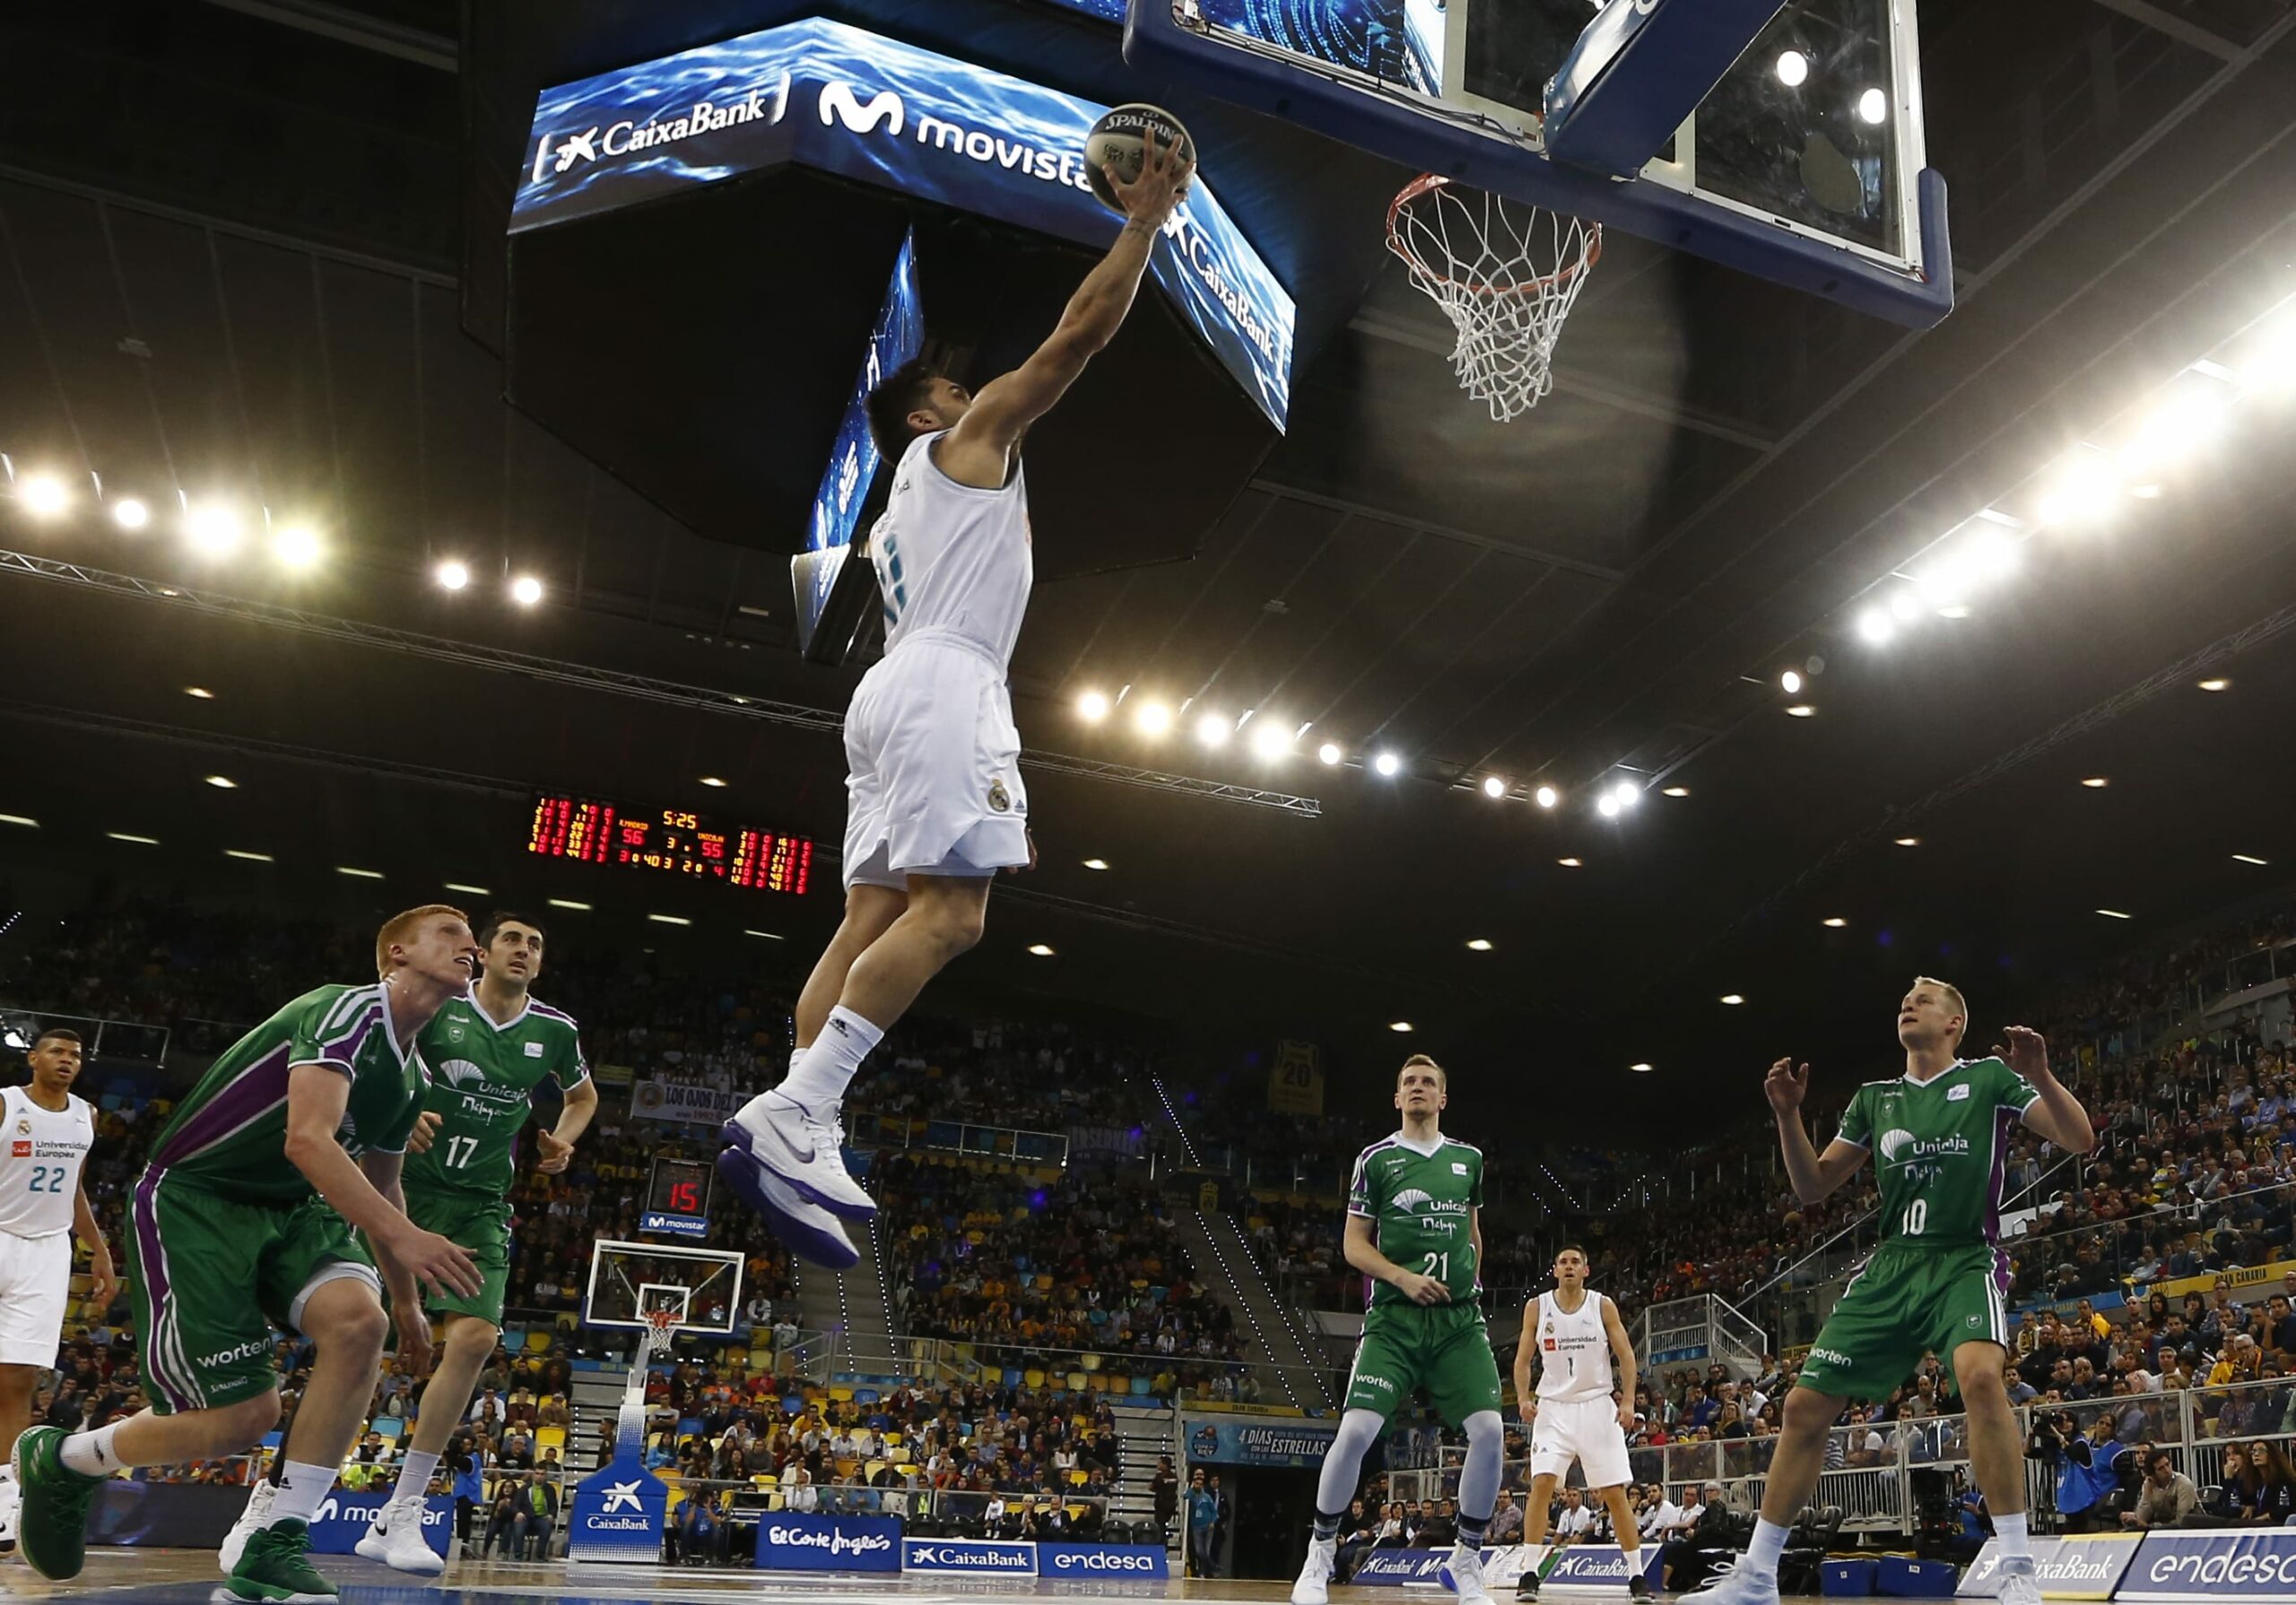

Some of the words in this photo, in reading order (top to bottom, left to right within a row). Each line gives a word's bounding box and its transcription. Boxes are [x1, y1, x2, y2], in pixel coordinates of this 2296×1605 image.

[602, 89, 765, 156] CaixaBank
[1105, 114, 1176, 141] SPALDIN
[917, 117, 1094, 194] movista
[1189, 235, 1274, 362] CaixaBank
[664, 810, 697, 830] 5:25
[622, 828, 644, 845] 56
[667, 836, 675, 849] 3
[701, 842, 724, 859] 55
[644, 854, 660, 868] 40
[664, 857, 673, 869] 3
[683, 859, 692, 873] 2
[1282, 1060, 1310, 1087] 20
[665, 1086, 684, 1104] LOS
[686, 1088, 712, 1109] OJOS
[713, 1093, 733, 1112] DEL
[35, 1149, 75, 1158] Europea
[446, 1135, 478, 1169] 17
[29, 1166, 65, 1192] 22
[670, 1182, 697, 1211] 15
[665, 1220, 706, 1230] movistar
[1901, 1199, 1927, 1235] 10
[1422, 1252, 1448, 1281] 21
[2236, 1267, 2267, 1284] CANARIA
[1557, 1335, 1597, 1344] Universidad
[196, 1337, 271, 1368] worten
[1568, 1356, 1573, 1377] 1
[1356, 1374, 1394, 1392] worten
[1239, 1429, 1246, 1443] 4
[1248, 1426, 1274, 1445] DÍAS
[1271, 1439, 1326, 1456] ESTRELLAS
[344, 1507, 445, 1525] moar
[587, 1515, 650, 1531] CaixaBank
[769, 1525, 787, 1546] El
[787, 1527, 830, 1548] Corte
[939, 1548, 1029, 1567] CaixaBank
[1054, 1551, 1154, 1571] endesa
[1374, 1557, 1416, 1574] CaixaBank
[1574, 1557, 1631, 1577] CaixaBan
[2035, 1554, 2113, 1579] ixaBank
